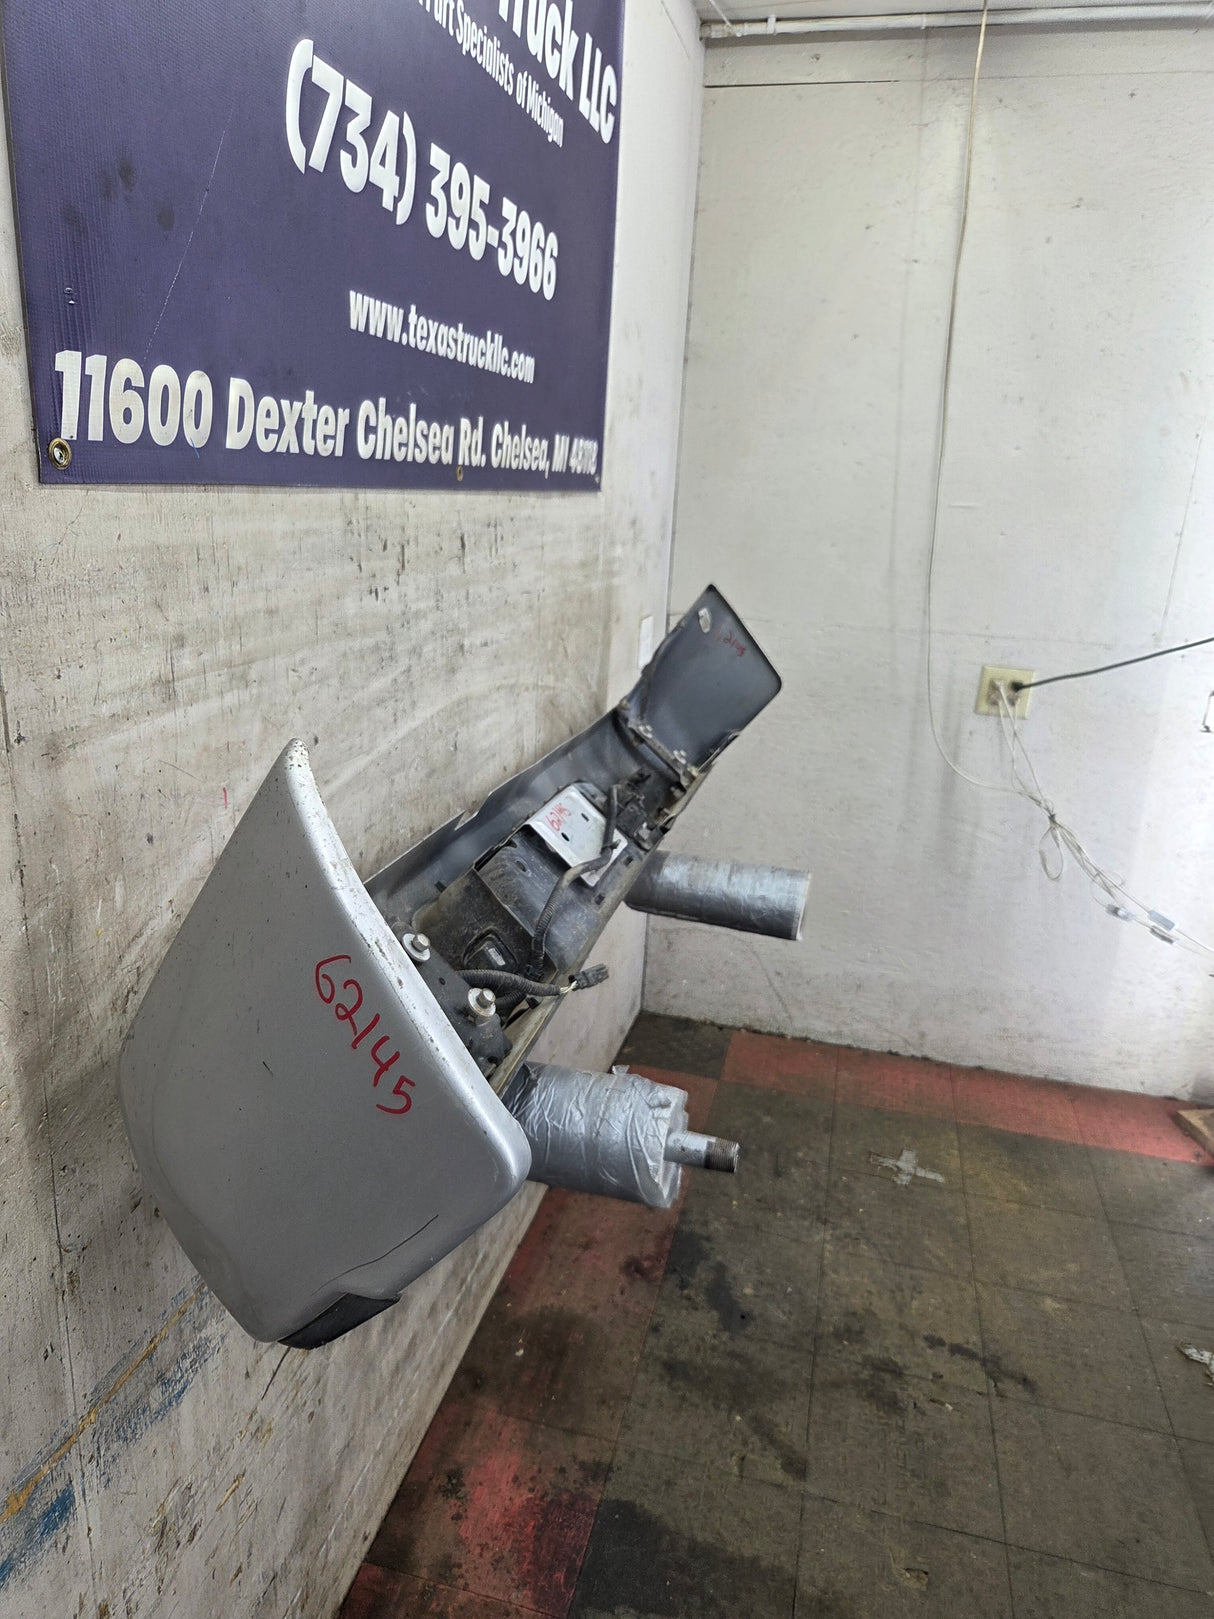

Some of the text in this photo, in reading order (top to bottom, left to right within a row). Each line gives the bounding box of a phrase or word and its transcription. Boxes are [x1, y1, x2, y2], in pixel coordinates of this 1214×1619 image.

[425, 0, 564, 148] art Specialists of Michigan
[578, 31, 617, 144] LLC
[285, 38, 558, 301] (734) 395-3966
[349, 290, 536, 384] www.texastruckllc.com
[54, 349, 213, 448] 11600
[225, 376, 351, 457] Dexter
[356, 397, 455, 464] Chelsea
[458, 416, 487, 467] Rd.
[490, 420, 550, 479] Chelsea,
[551, 433, 571, 473] MI
[314, 954, 416, 1115] 62145
